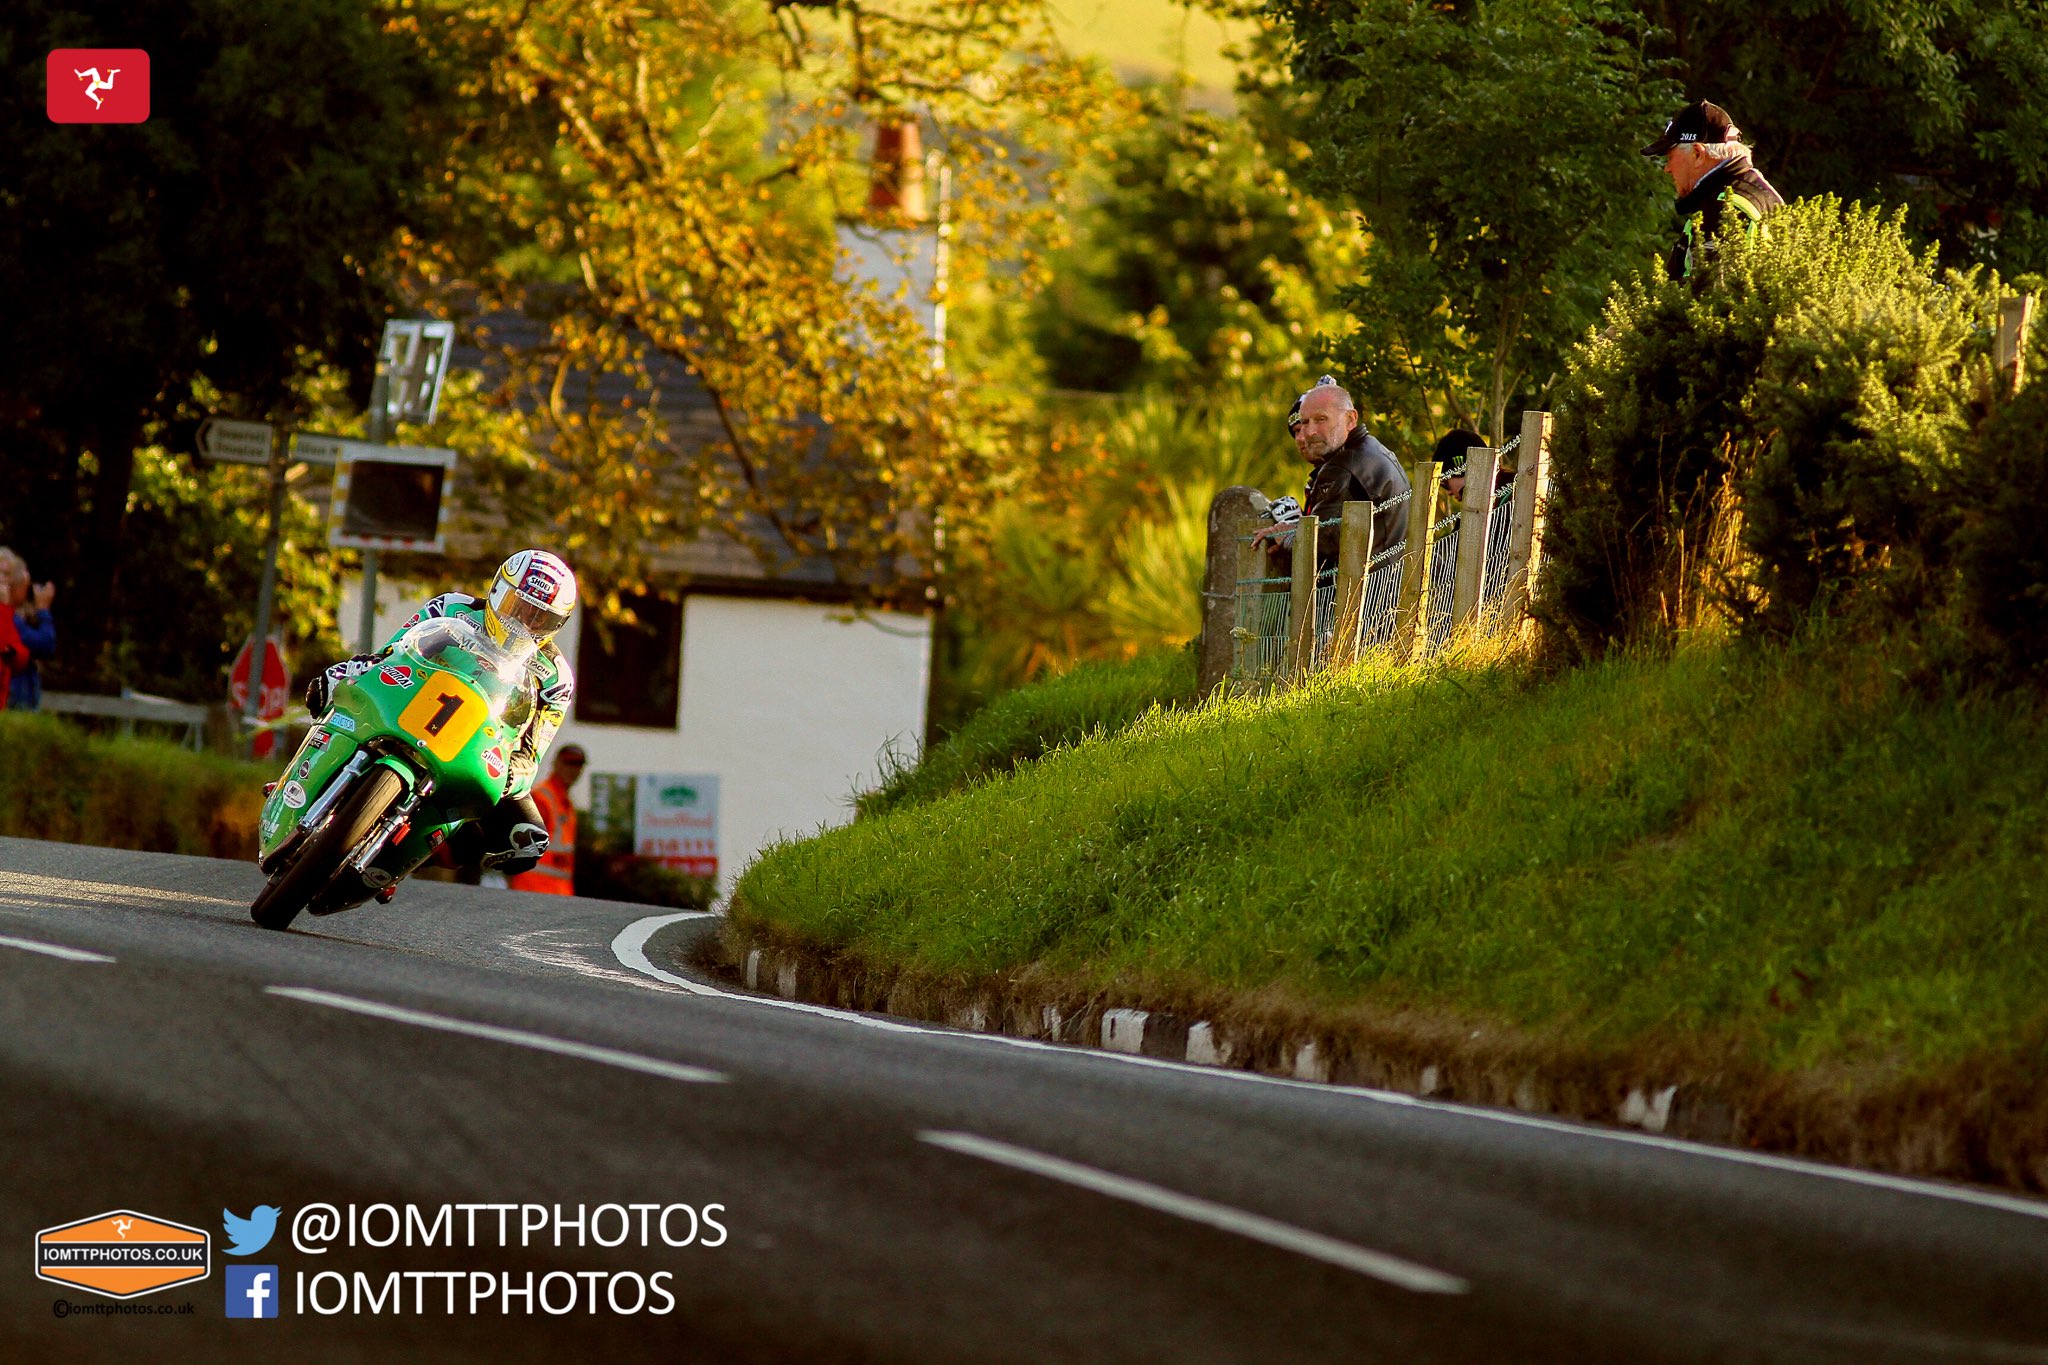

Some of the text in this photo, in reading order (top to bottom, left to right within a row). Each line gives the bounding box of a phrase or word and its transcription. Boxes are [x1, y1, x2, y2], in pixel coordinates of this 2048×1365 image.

[531, 577, 551, 592] SHOEI
[379, 665, 413, 689] SHORAI
[424, 692, 465, 738] 1
